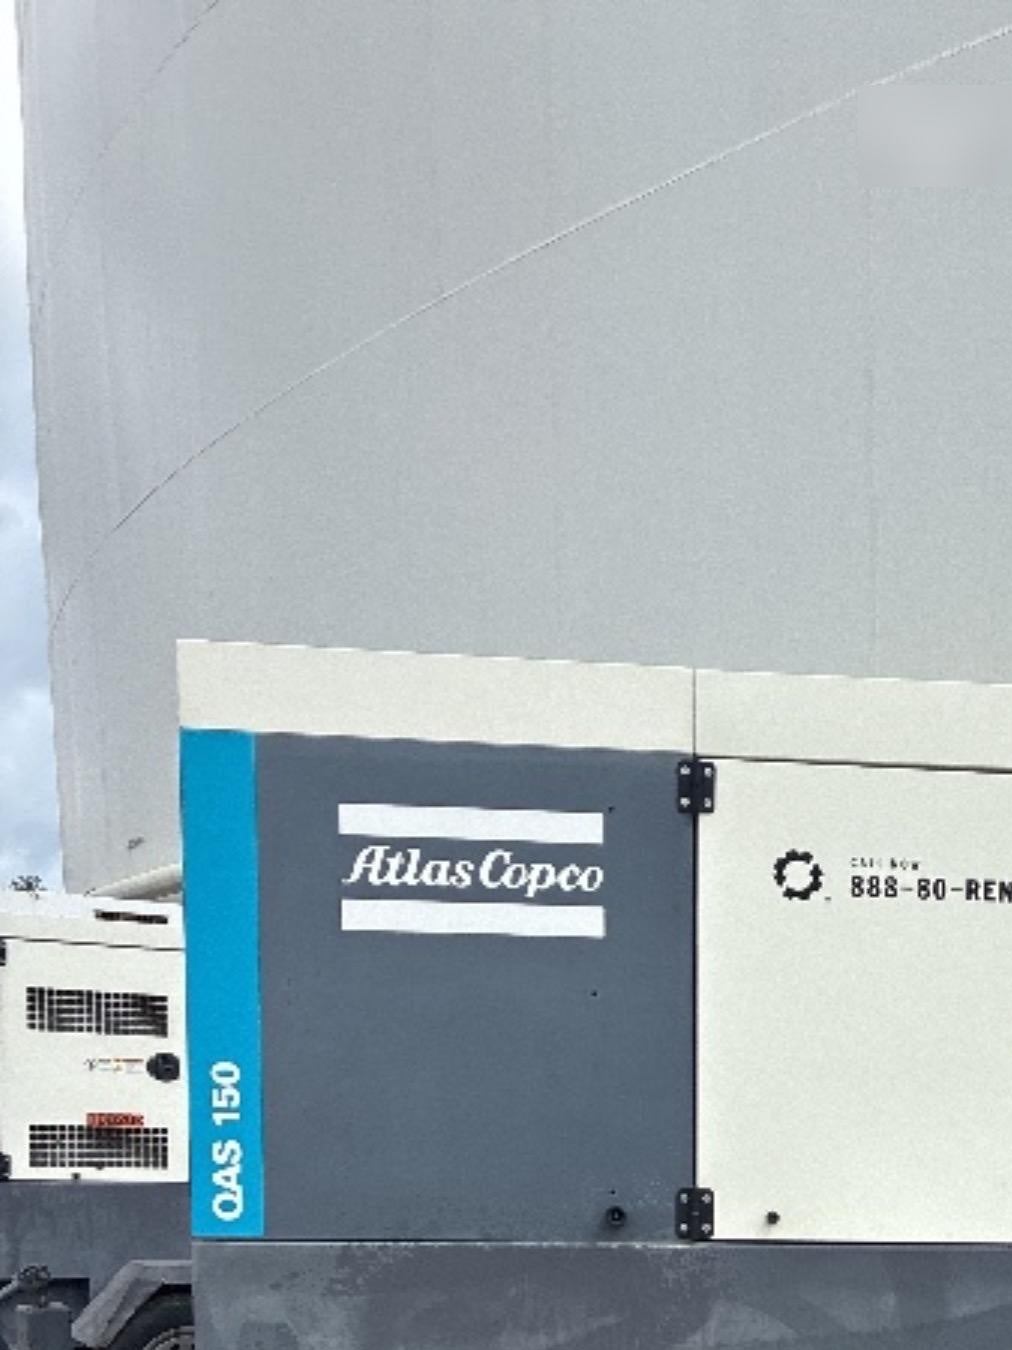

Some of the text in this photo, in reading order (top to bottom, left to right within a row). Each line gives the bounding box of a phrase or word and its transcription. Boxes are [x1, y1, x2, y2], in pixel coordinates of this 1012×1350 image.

[342, 845, 604, 898] Atlas Copco
[212, 1061, 244, 1221] QAS 150
